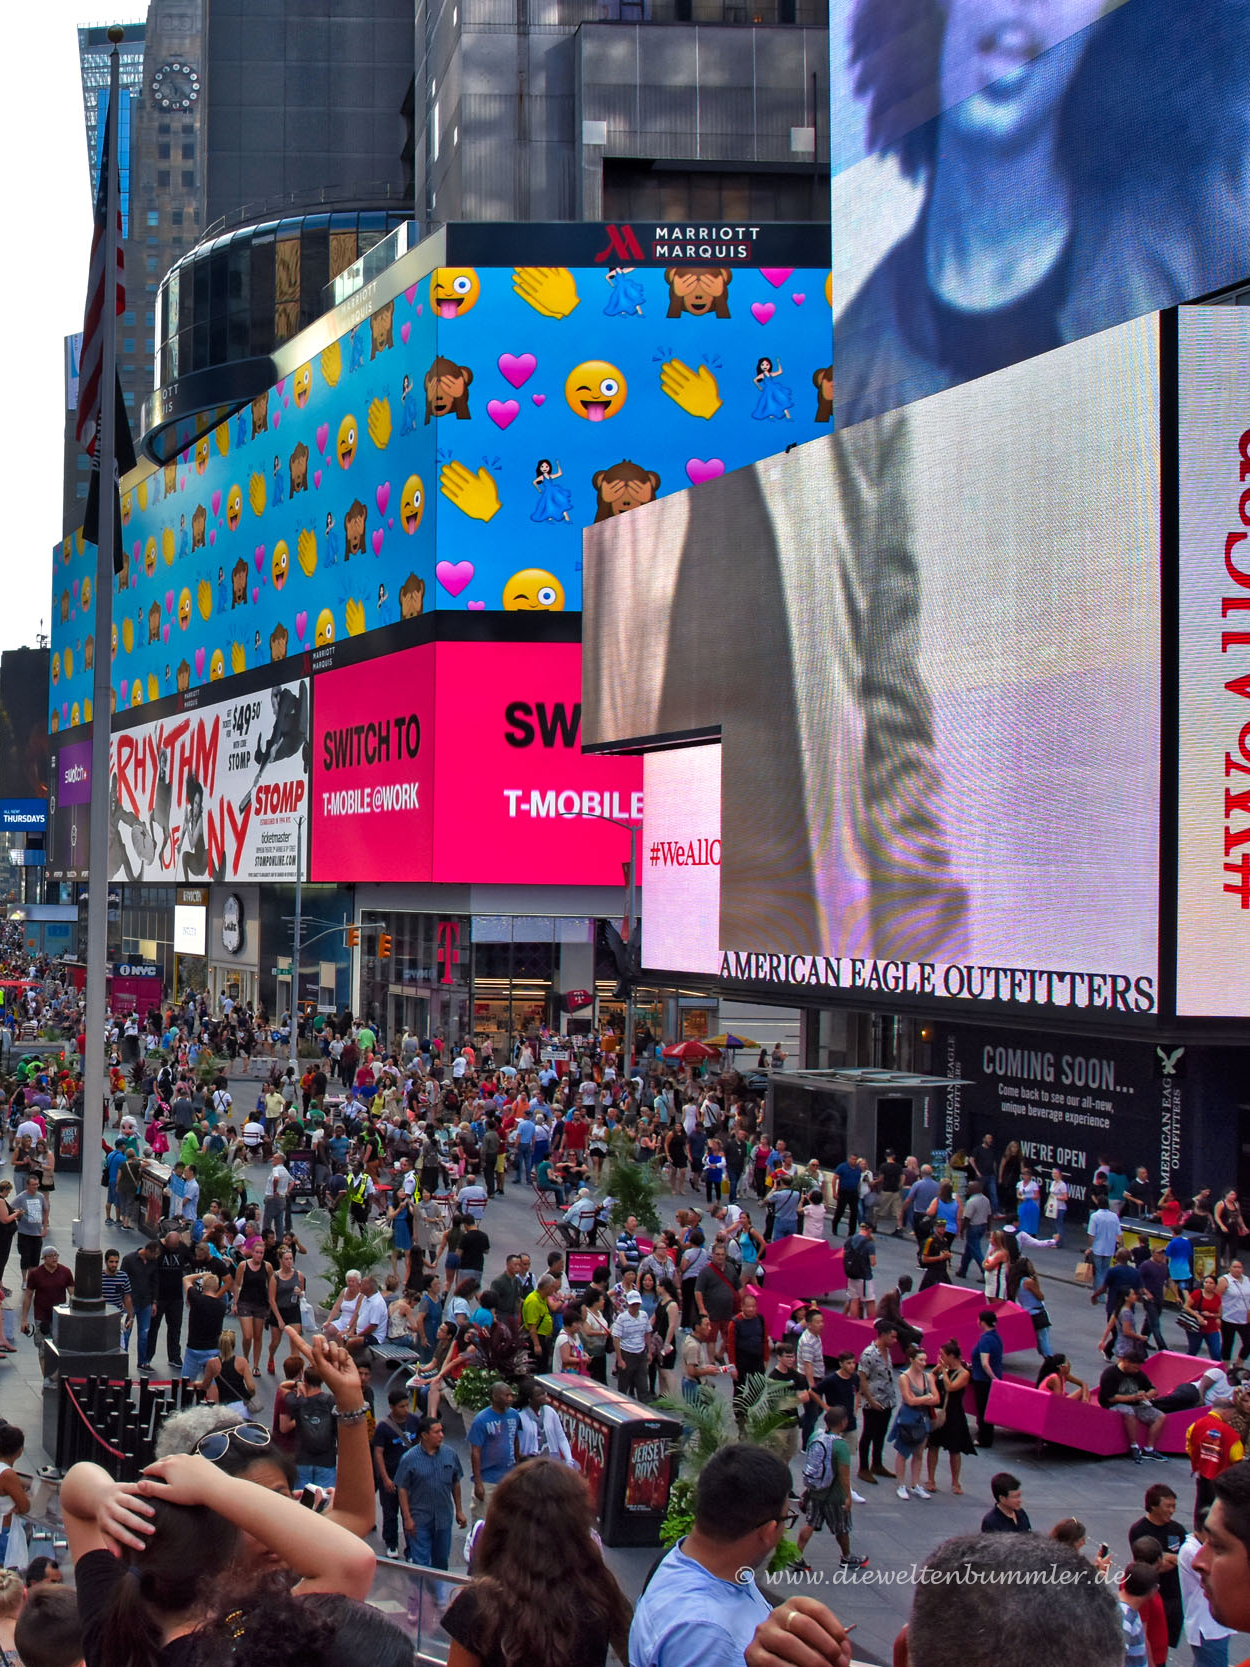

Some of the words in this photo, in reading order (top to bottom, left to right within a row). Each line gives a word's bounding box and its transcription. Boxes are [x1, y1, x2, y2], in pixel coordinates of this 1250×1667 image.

[655, 227, 760, 240] MARRIOTT
[655, 245, 748, 258] MARQUIS
[312, 647, 335, 660] MARRIOTT
[312, 659, 333, 670] MARQUIS
[323, 719, 391, 772] SWITCH
[397, 713, 421, 760] TO
[116, 714, 220, 819] RHYTHM
[228, 751, 251, 772] STOMP
[254, 779, 305, 817] STOMP
[322, 787, 371, 816] T-MOBILE
[372, 782, 419, 813] @WORK
[503, 789, 643, 819] T-MOBILE
[3, 815, 45, 823] THURSDAYS
[207, 794, 252, 878] NY
[261, 831, 292, 844] ticketmaster
[254, 855, 296, 867] STOMPONLINE.COM
[131, 966, 157, 976] NYC
[719, 951, 843, 988] AMERICAN
[849, 959, 936, 995] EAGLE
[942, 964, 1156, 1014] OUTFITTERS
[983, 1045, 1055, 1083] COMING
[1061, 1054, 1135, 1094] SOON...
[998, 1083, 1020, 1098] Come
[1020, 1085, 1040, 1101] back
[1040, 1089, 1050, 1103] to
[1050, 1093, 1065, 1104] see
[1066, 1095, 1080, 1107] our
[1081, 1095, 1115, 1114] all-new,
[1001, 1101, 1026, 1117] unique
[1027, 1104, 1063, 1123] beverage
[1065, 1111, 1110, 1129] experience
[1171, 1088, 1182, 1170] OUTFITTERS
[1020, 1140, 1054, 1162] WE'RE
[1056, 1147, 1086, 1170] OPEN
[1068, 1186, 1087, 1201] WAY
[632, 1440, 665, 1464] JERSEY
[635, 1461, 659, 1480] BOYS
